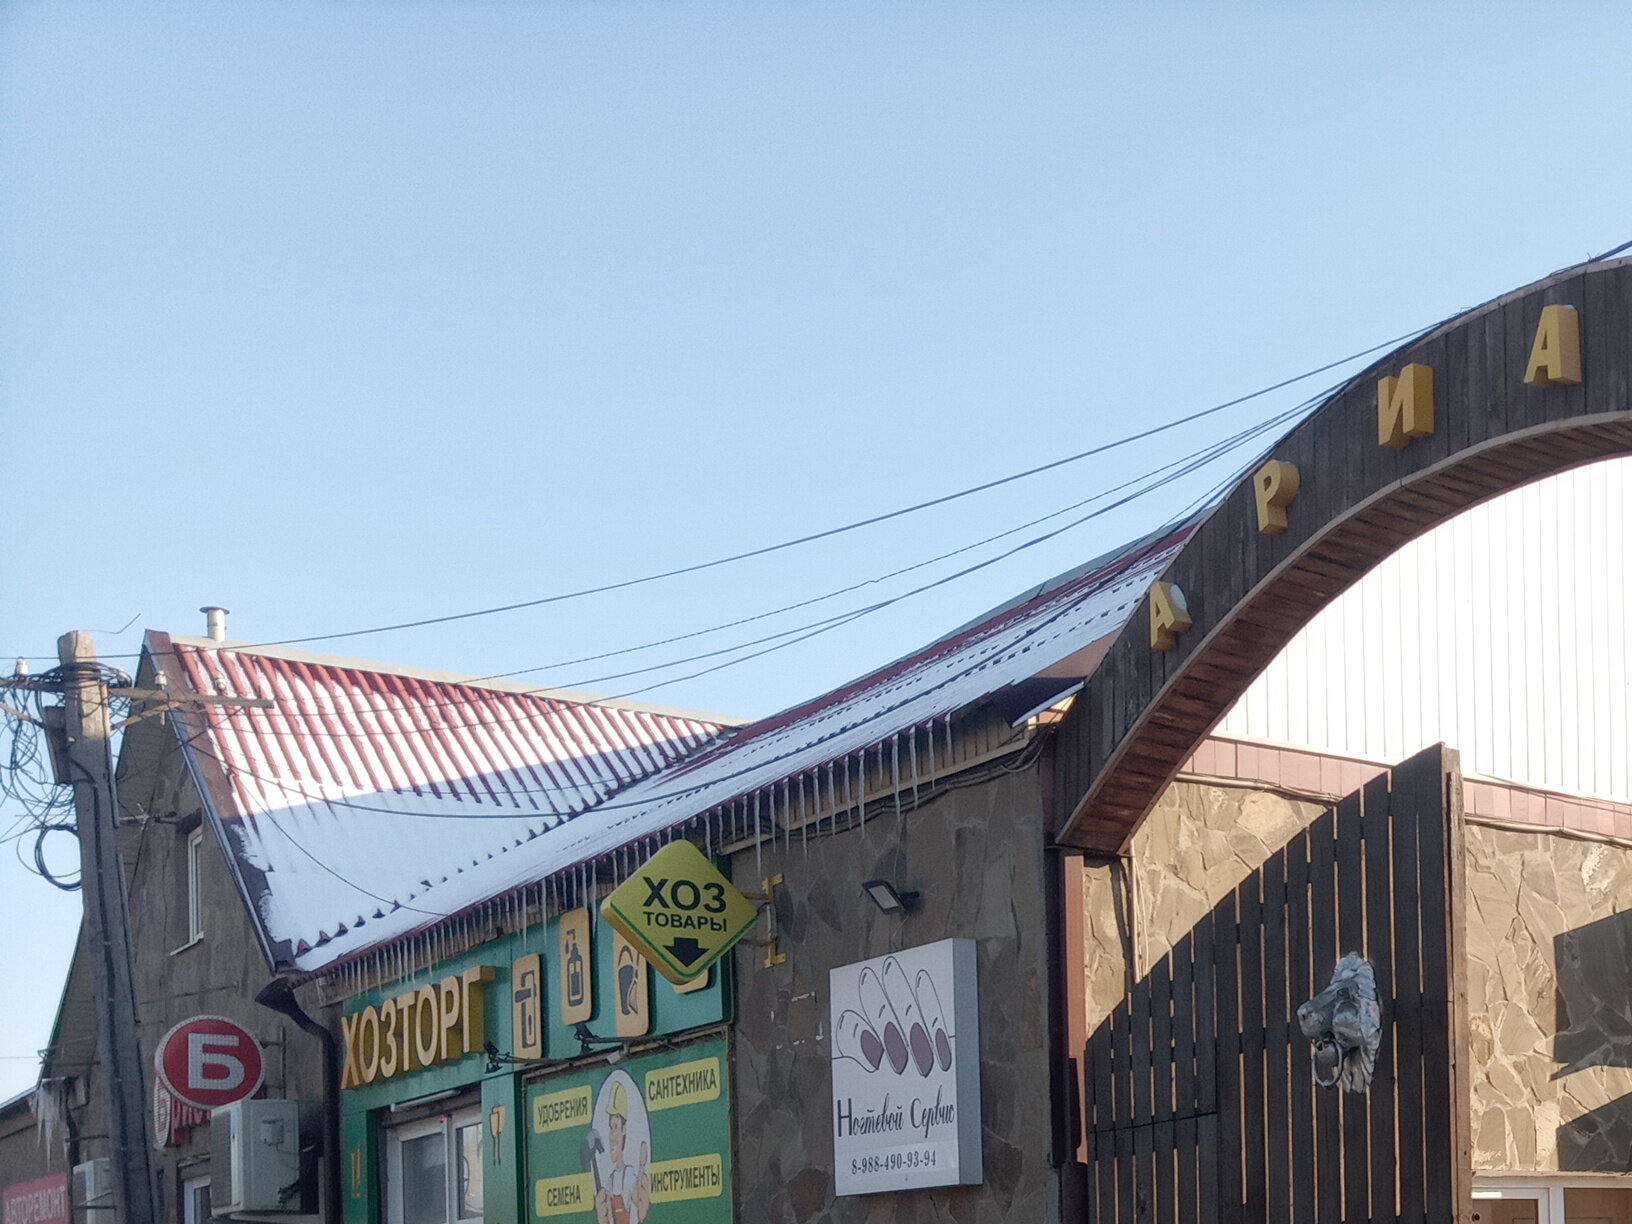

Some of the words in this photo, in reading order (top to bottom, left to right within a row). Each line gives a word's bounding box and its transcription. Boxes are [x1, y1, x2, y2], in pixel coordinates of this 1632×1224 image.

[642, 876, 728, 914] ХОЗ
[643, 911, 728, 932] ТОВАРЫ
[340, 965, 496, 1090] ХОЗТОРГ
[188, 1032, 245, 1090] Б
[647, 1065, 718, 1102] САНТЕХНИКА
[537, 1095, 588, 1128] УДОБРЕНИЯ
[837, 1093, 903, 1137] Ногтевой
[910, 1084, 955, 1138] Сервис
[649, 1162, 720, 1195] ИНСТРУМЕНТЫ
[851, 1150, 936, 1175] 8-988-490-93-94
[546, 1184, 581, 1208] СЕМЕНА
